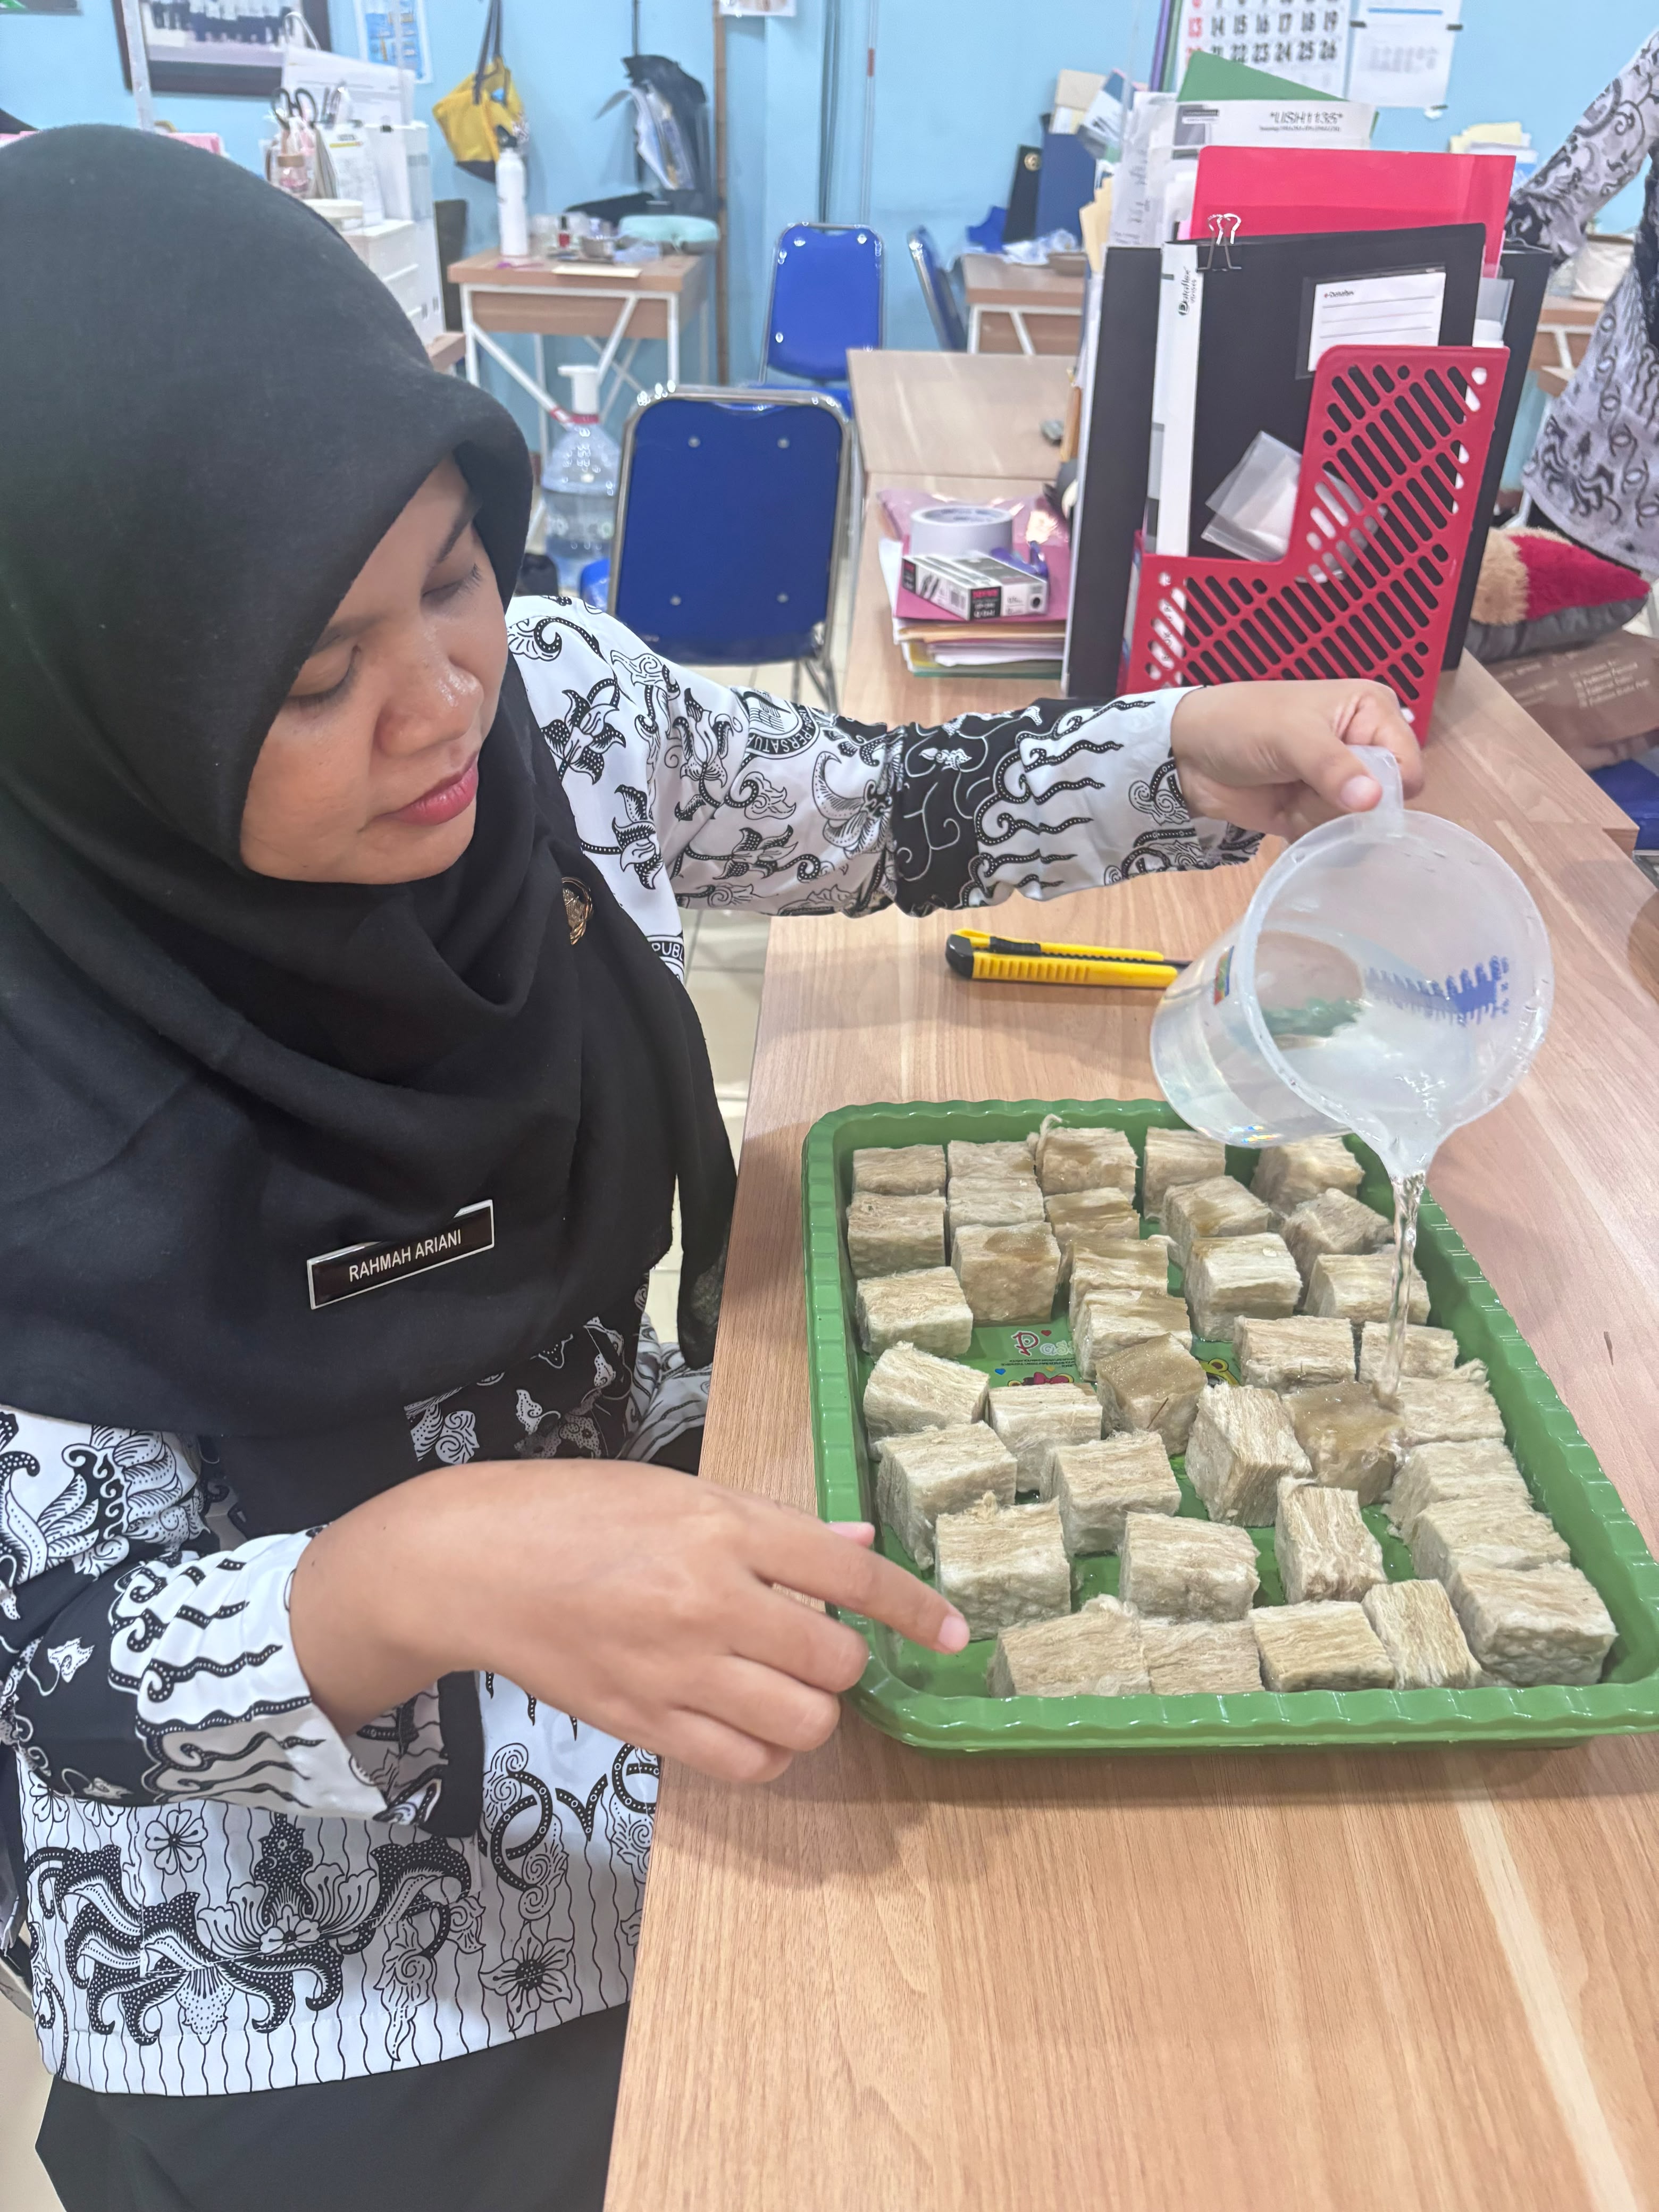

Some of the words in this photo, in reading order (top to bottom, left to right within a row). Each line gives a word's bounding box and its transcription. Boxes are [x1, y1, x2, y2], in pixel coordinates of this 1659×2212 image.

[1211, 16, 1225, 37] 14
[1233, 14, 1247, 35] 15
[1278, 12, 1293, 33] 17
[1323, 10, 1339, 31] 19
[1275, 41, 1292, 62] 24
[1297, 40, 1315, 62] 25
[1319, 39, 1337, 60] 26
[349, 1246, 412, 1282] RAHMAH
[415, 1229, 461, 1259] ARIANI
